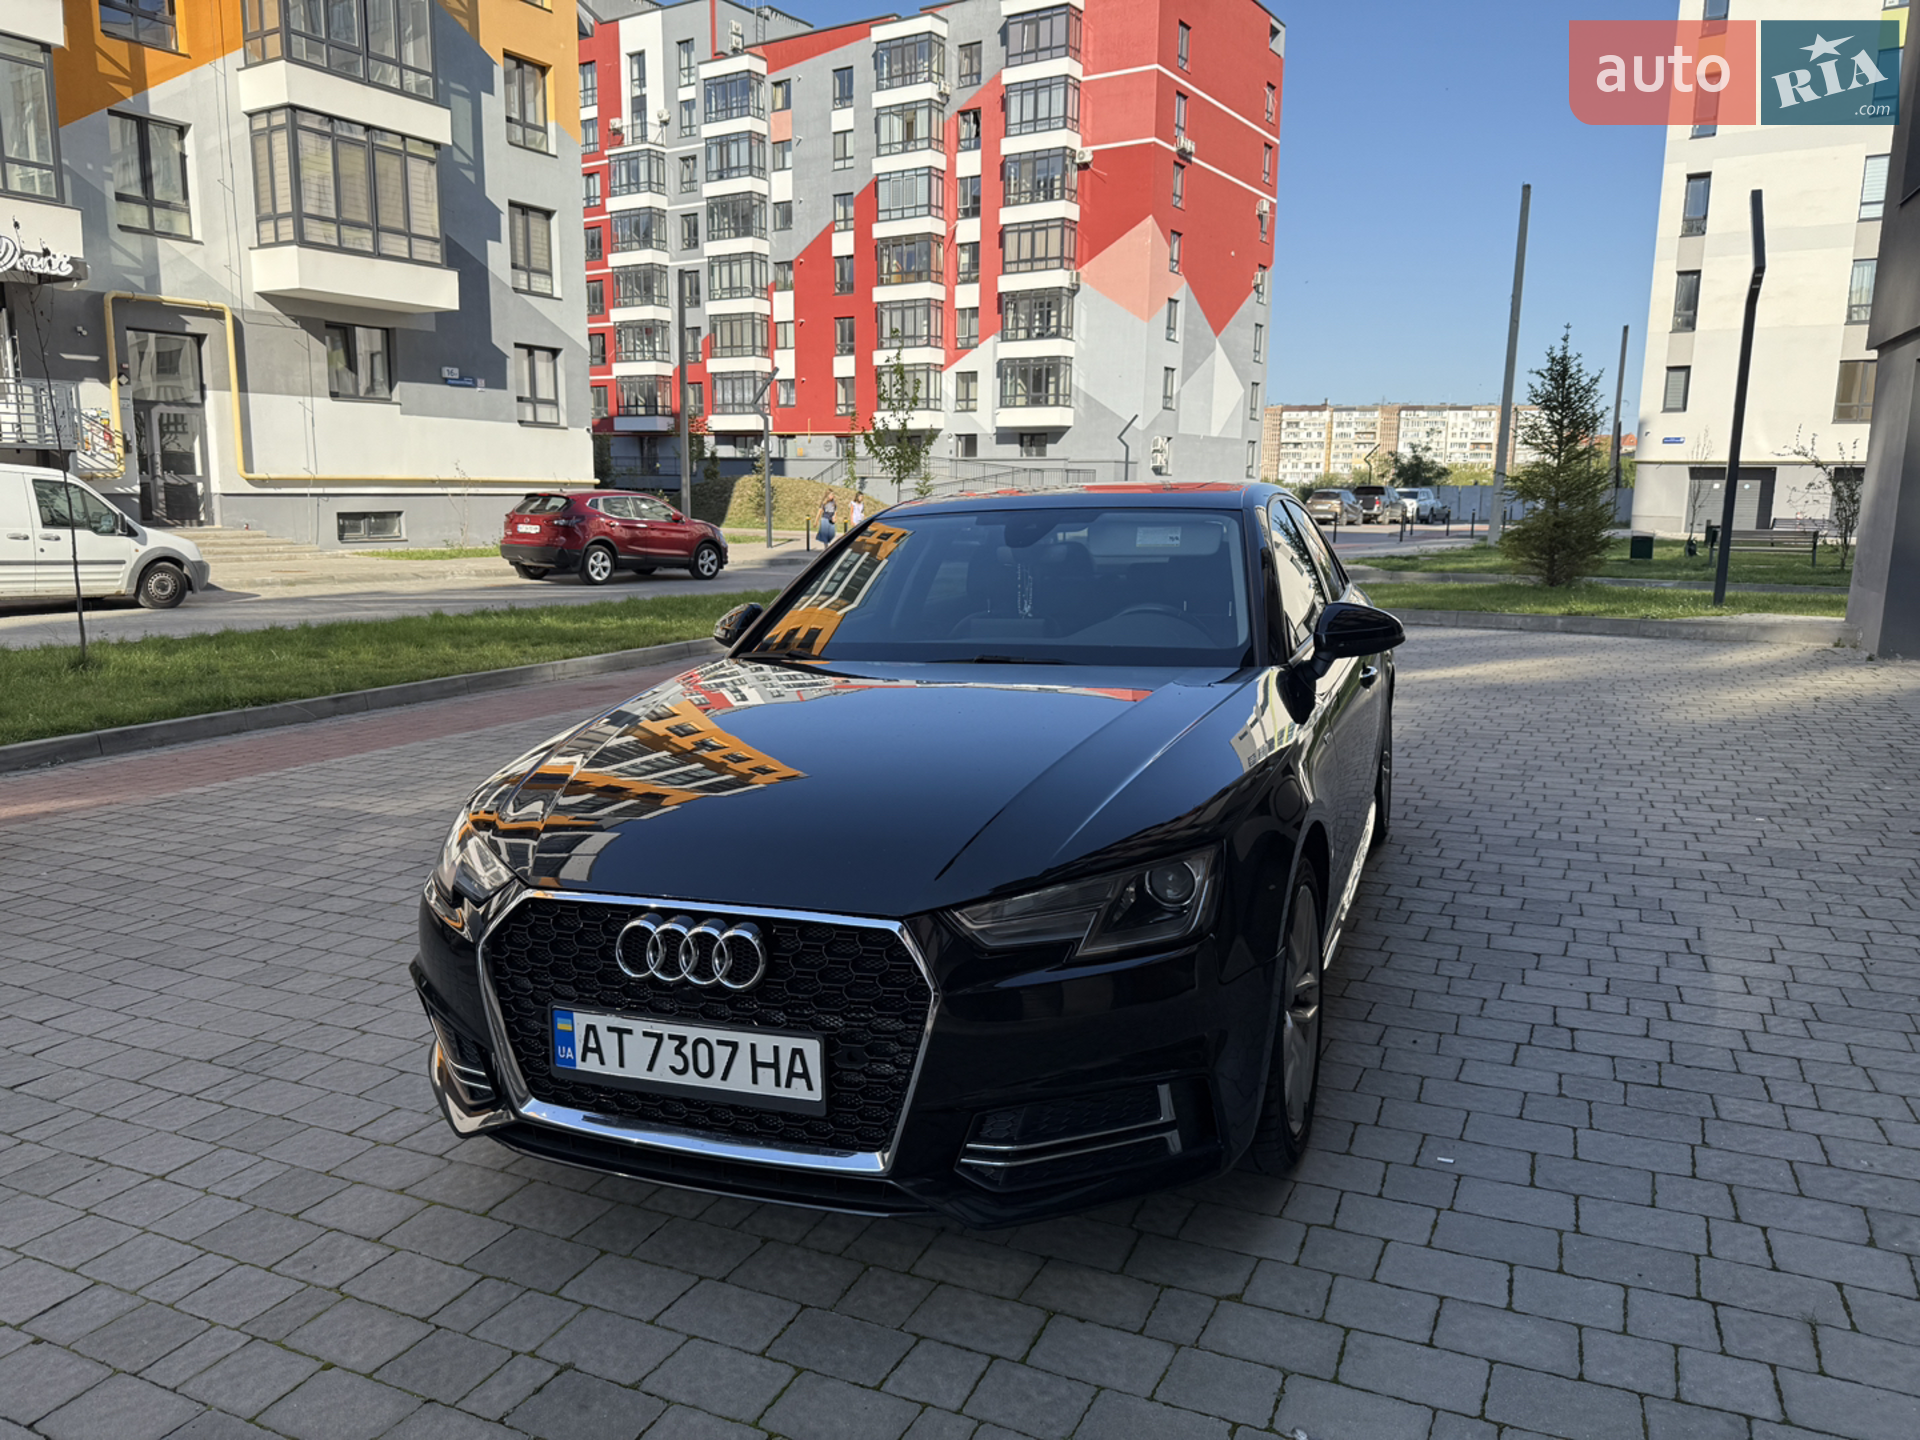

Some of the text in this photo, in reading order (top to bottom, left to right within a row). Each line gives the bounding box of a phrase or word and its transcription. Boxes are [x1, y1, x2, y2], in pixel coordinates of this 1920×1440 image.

[558, 1045, 574, 1060] UA
[580, 1023, 814, 1091] AT 7307 HA
